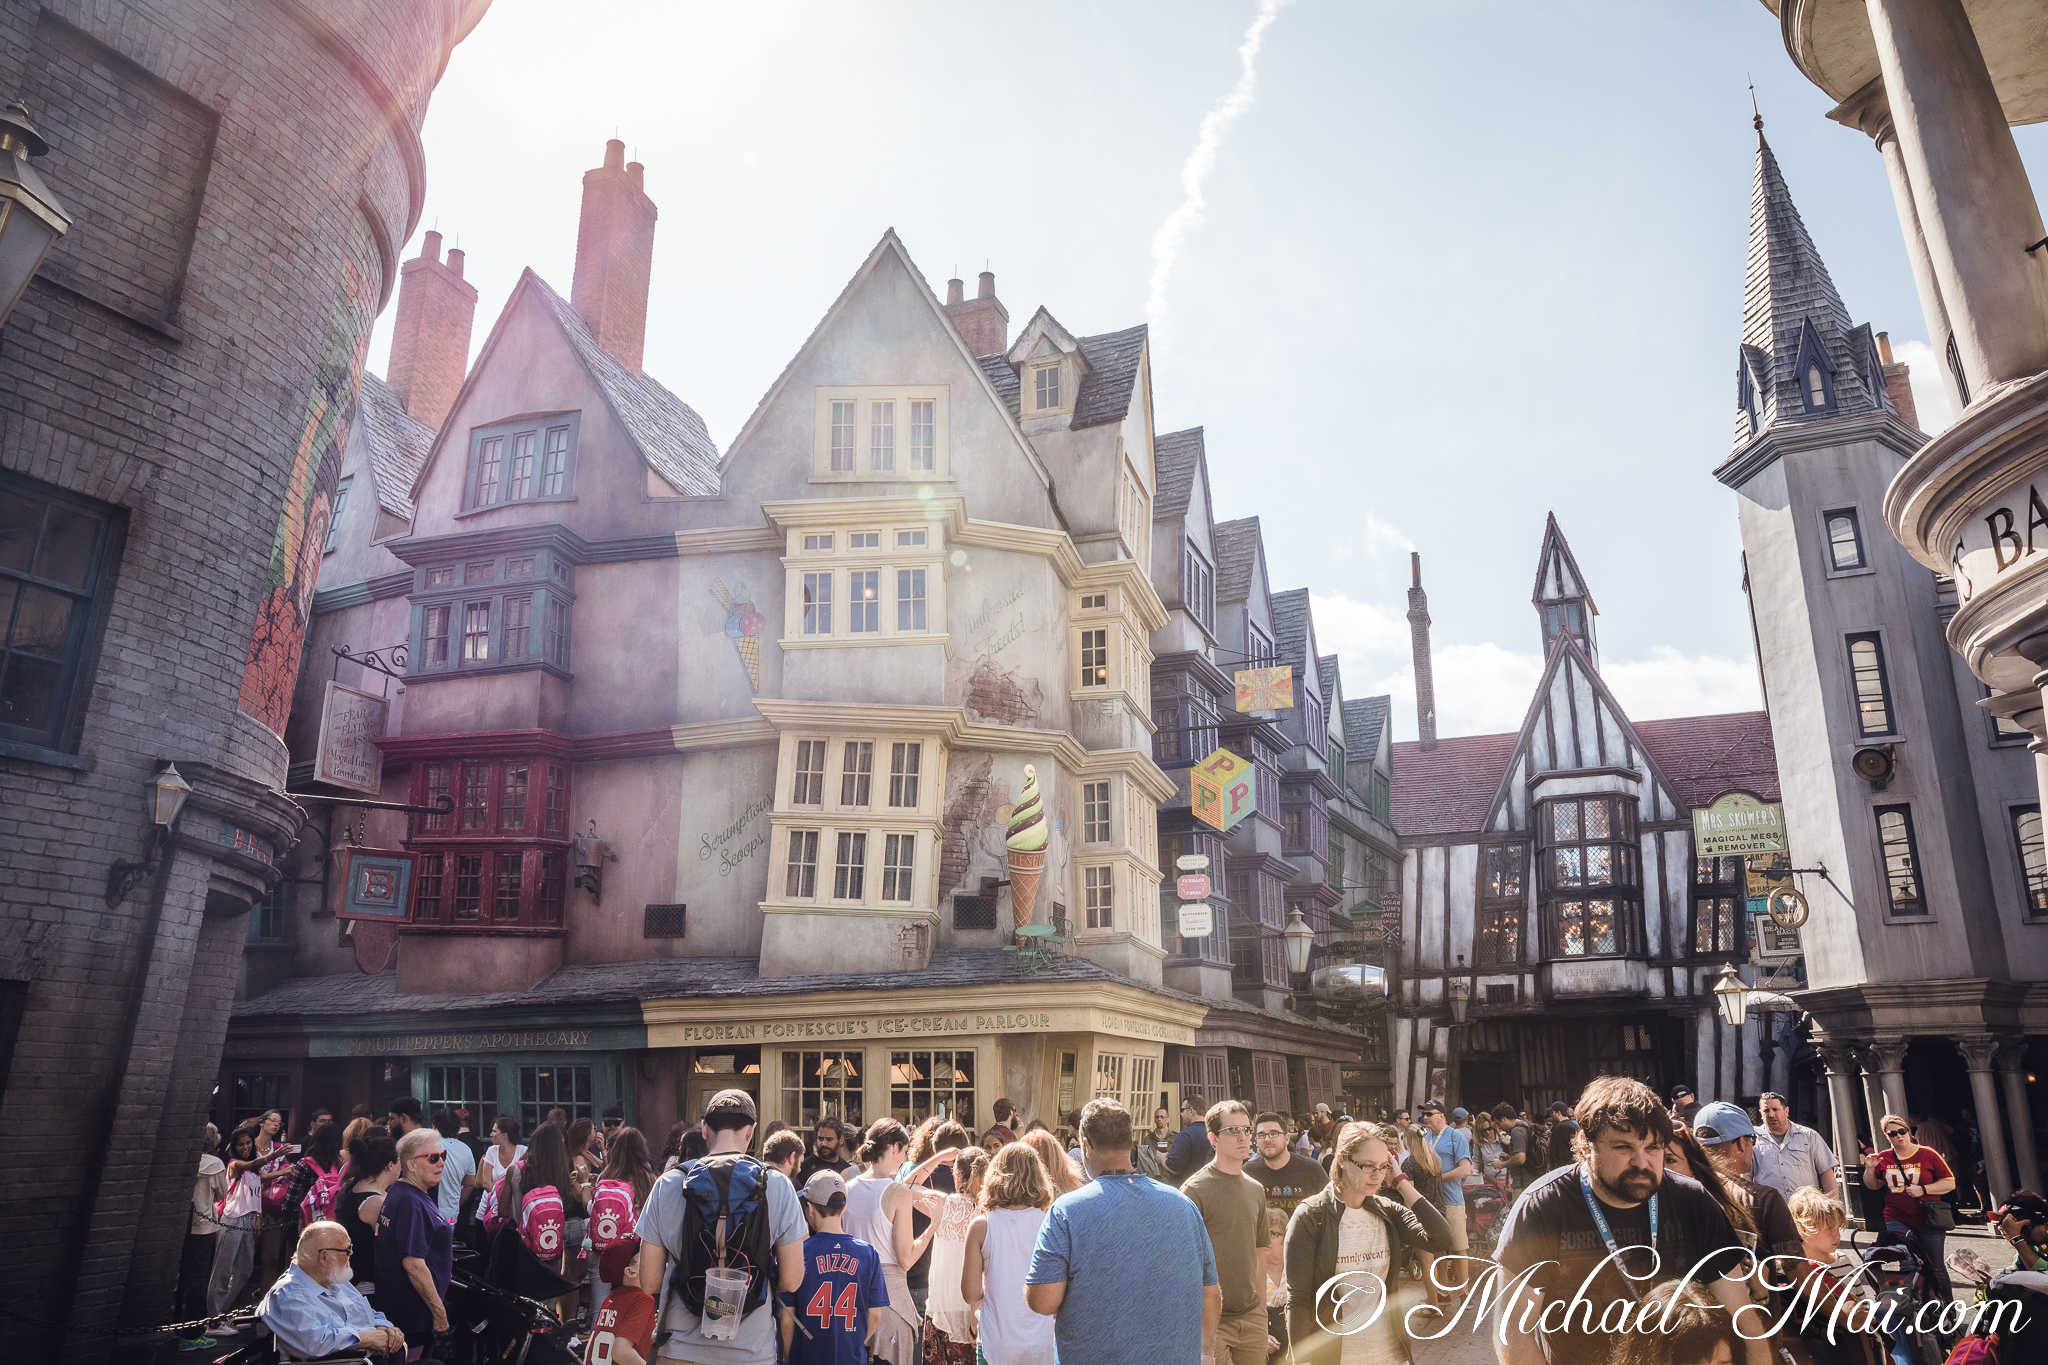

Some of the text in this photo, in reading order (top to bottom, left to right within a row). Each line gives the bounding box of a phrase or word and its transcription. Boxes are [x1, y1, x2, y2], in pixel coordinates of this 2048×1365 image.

[343, 708, 366, 721] FEAR
[699, 793, 774, 861] Scrumptious
[1728, 805, 1777, 827] SKOWER'S
[1703, 832, 1779, 843] MAGICAL MESS
[1717, 842, 1766, 851] REMOVER
[719, 832, 766, 877] Scoops
[684, 1012, 1051, 1041] FLOREAN FORTESCUE'S ICE-CREAM PARLOUR
[479, 1030, 592, 1048] APOTHECARY
[1586, 1193, 1608, 1234] PASSHOLDER
[815, 1253, 860, 1276] RIZZO
[1362, 1249, 1384, 1262] swear
[806, 1281, 858, 1330] 44
